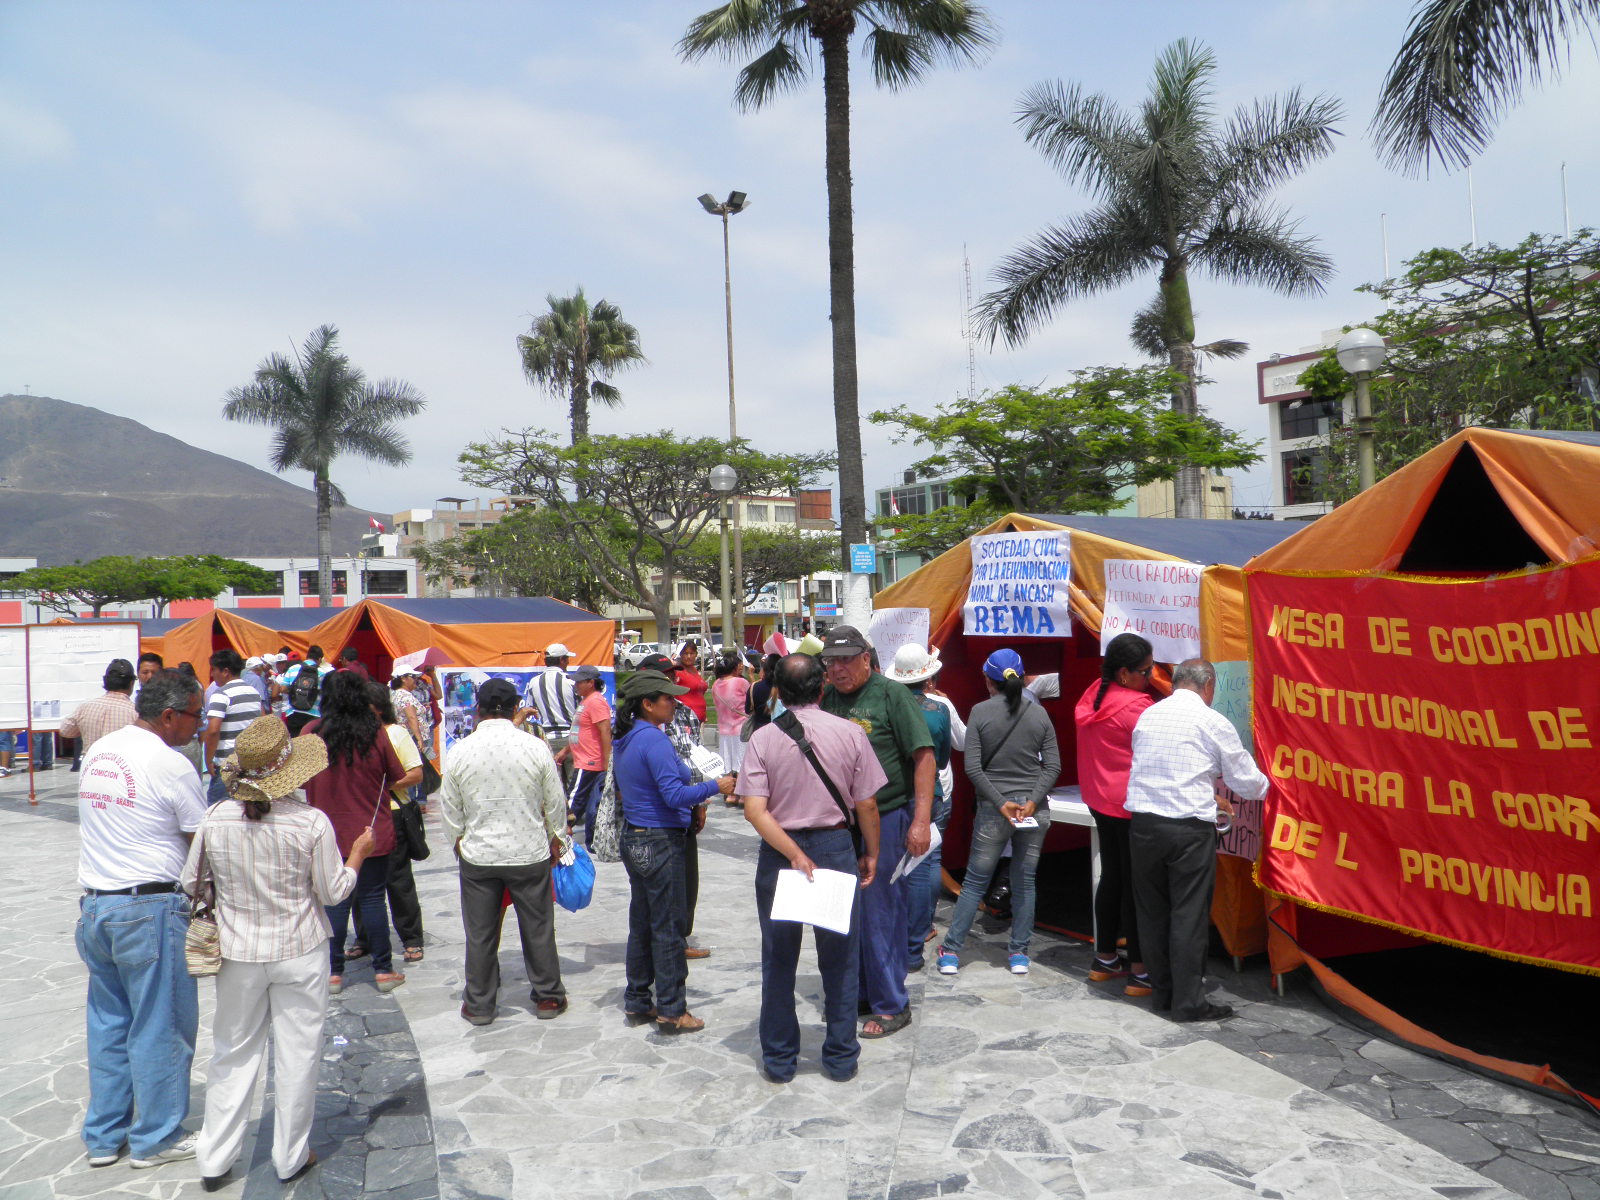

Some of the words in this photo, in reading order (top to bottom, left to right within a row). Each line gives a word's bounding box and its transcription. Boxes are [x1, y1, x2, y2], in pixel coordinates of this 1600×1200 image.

[981, 538, 1030, 559] SOCIEDAD
[1033, 538, 1062, 557] CIVIL
[974, 563, 988, 582] POR
[989, 562, 999, 580] LA
[1001, 560, 1069, 581] REIVINDICACION
[969, 584, 994, 603] MORAL
[997, 583, 1010, 602] DE
[1014, 583, 1055, 603] ANCASH
[1160, 595, 1169, 606] AL
[974, 604, 1056, 634] REMA
[1104, 616, 1119, 630] NO
[1124, 618, 1132, 631] A
[1136, 618, 1147, 633] LA
[1150, 620, 1200, 641] CORRUPCION
[1267, 605, 1345, 649] MESA
[1367, 616, 1412, 656] DE
[1272, 674, 1518, 749] INSTITUCIONAL
[1527, 707, 1592, 750] DE
[91, 768, 119, 779] COMICION
[1271, 744, 1404, 809] CONTRA
[1423, 776, 1476, 819] LA
[91, 800, 107, 810] LIMA
[116, 797, 135, 808] BRASIL
[1270, 813, 1322, 859] DE
[1399, 847, 1592, 918] PROVINCIA
